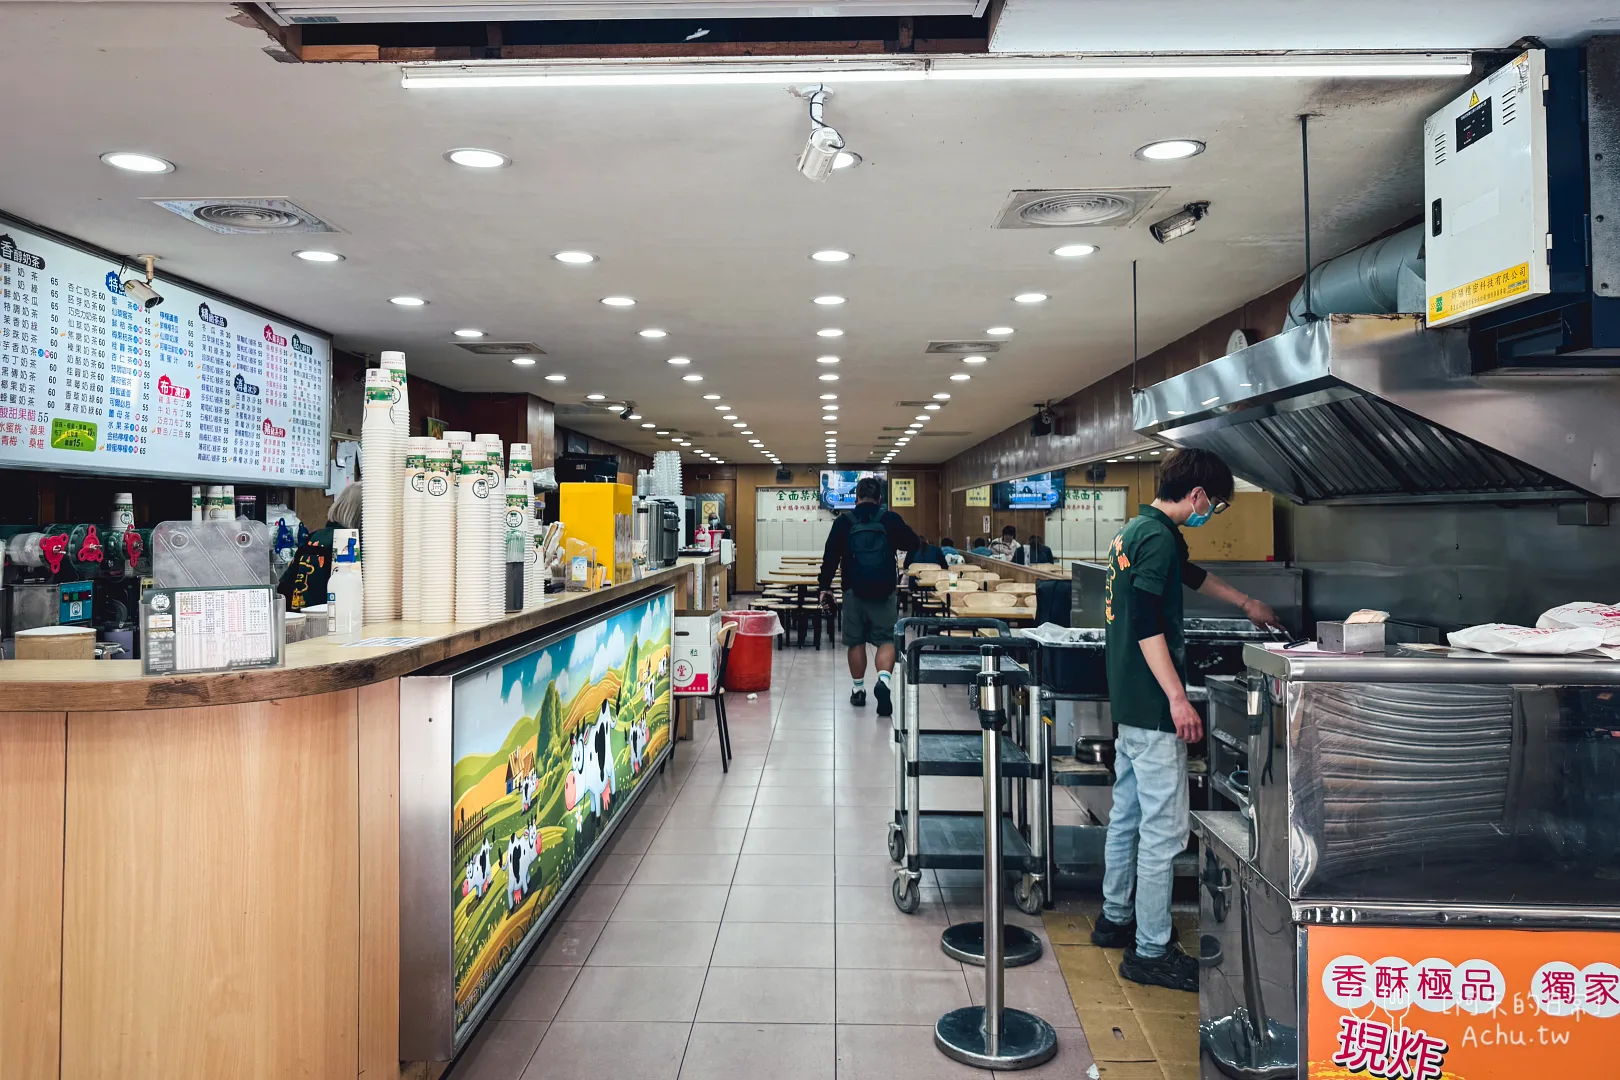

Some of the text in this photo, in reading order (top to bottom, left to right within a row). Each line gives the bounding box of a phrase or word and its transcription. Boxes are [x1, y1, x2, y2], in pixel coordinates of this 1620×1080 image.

[0, 239, 39, 268] 香醇奶茶
[3, 262, 58, 286] 鮮奶茶 65
[51, 289, 58, 298] 65
[67, 282, 105, 301] 杏仁奶茶 60
[3, 288, 58, 310] 鮮奶冬瓜 65
[3, 301, 58, 323] 特調奶茶 50
[98, 302, 105, 312] 60
[67, 306, 105, 324] 巧克力奶茶 60
[50, 325, 58, 335] 50
[67, 318, 105, 335] 仙草奶茶 60
[144, 327, 150, 336] 55
[2, 326, 57, 347] 珍珠奶茶 60
[67, 330, 105, 346] 焦糖奶茶 60
[144, 338, 150, 346] 55
[201, 333, 224, 346] 古早味紅茶
[2, 340, 57, 360] 芋香奶茶 60
[98, 349, 104, 358] 60
[144, 349, 150, 357] 55
[2, 353, 56, 372] 布丁奶茶 60
[98, 360, 104, 369] 60
[111, 352, 149, 368] 杏仁茶 55
[48, 374, 56, 384] 60
[97, 372, 104, 381] 60
[143, 370, 149, 379] 55
[0, 379, 55, 396] 椰果奶茶 60
[96, 383, 103, 392] 60
[143, 381, 149, 389] 55
[0, 392, 54, 408] 蜂蜜奶茶 60
[96, 395, 102, 404] 60
[0, 405, 48, 423] 酸甜果醋 55
[95, 406, 102, 415] 60
[158, 405, 191, 418] 牛奶布丁 55
[141, 414, 148, 422] 55
[107, 420, 147, 433] 水果茶 65
[140, 436, 146, 444] 65
[1332, 965, 1620, 1006] 香酥極品 獨家
[1334, 1018, 1444, 1080] 現炸
